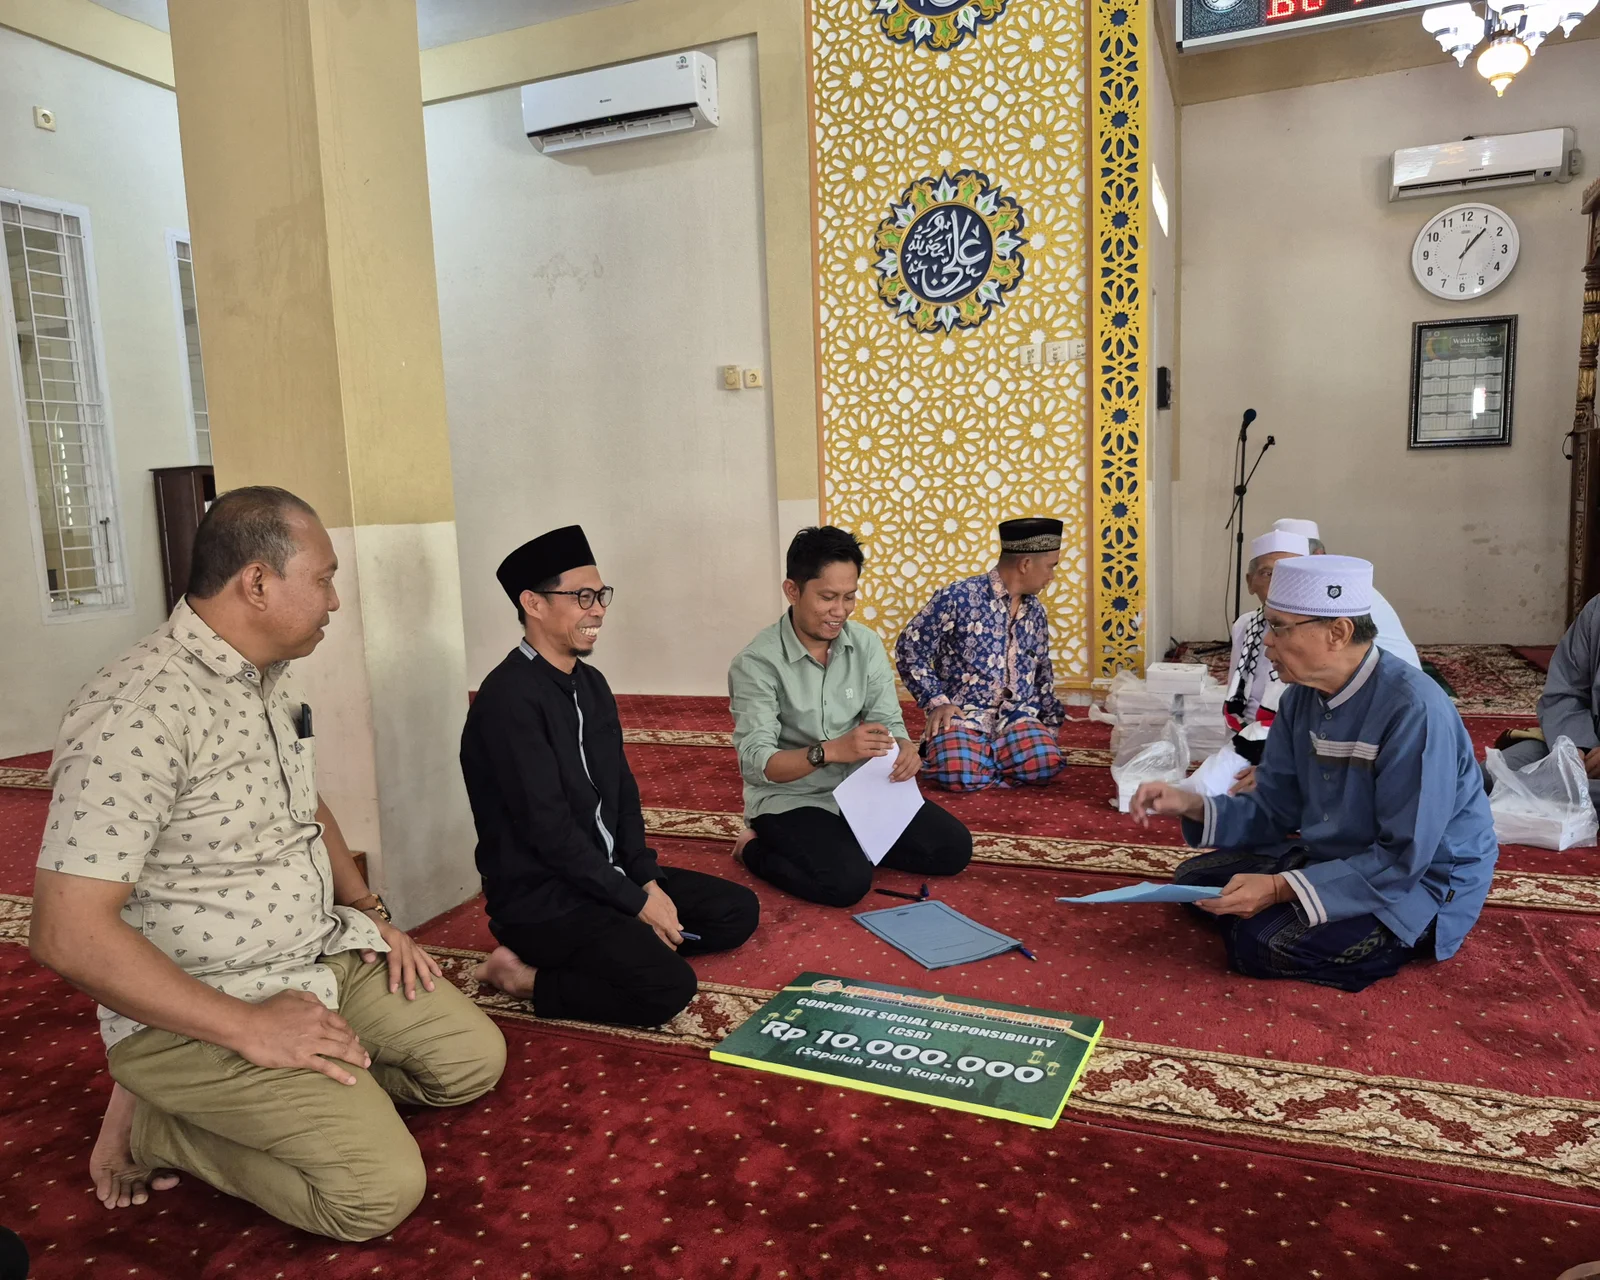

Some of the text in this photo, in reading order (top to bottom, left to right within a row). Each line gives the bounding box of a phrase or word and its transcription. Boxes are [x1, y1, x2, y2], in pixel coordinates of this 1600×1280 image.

[1461, 211, 1474, 222] 12
[1484, 214, 1489, 225] 1
[1441, 218, 1453, 228] 11
[1496, 226, 1503, 237] 2
[1427, 232, 1440, 242] 10
[1501, 244, 1508, 254] 3
[1423, 250, 1429, 260] 9
[1427, 266, 1433, 276] 8
[1493, 261, 1500, 271] 4
[1440, 279, 1447, 288] 7
[1478, 276, 1485, 286] 5
[1459, 283, 1465, 292] 6
[1476, 335, 1498, 343] Sholat
[844, 985, 1073, 1029] LEMBAGA SERTIFIKASI KOMPETENSI
[796, 997, 1056, 1048] CORPORATE SOCIAL RESPONSIBILITY
[887, 1026, 932, 1040] (CSR)
[815, 1030, 1044, 1083] 10.000.000
[795, 1046, 975, 1088] (Sepuluh Juta Rupiah)
